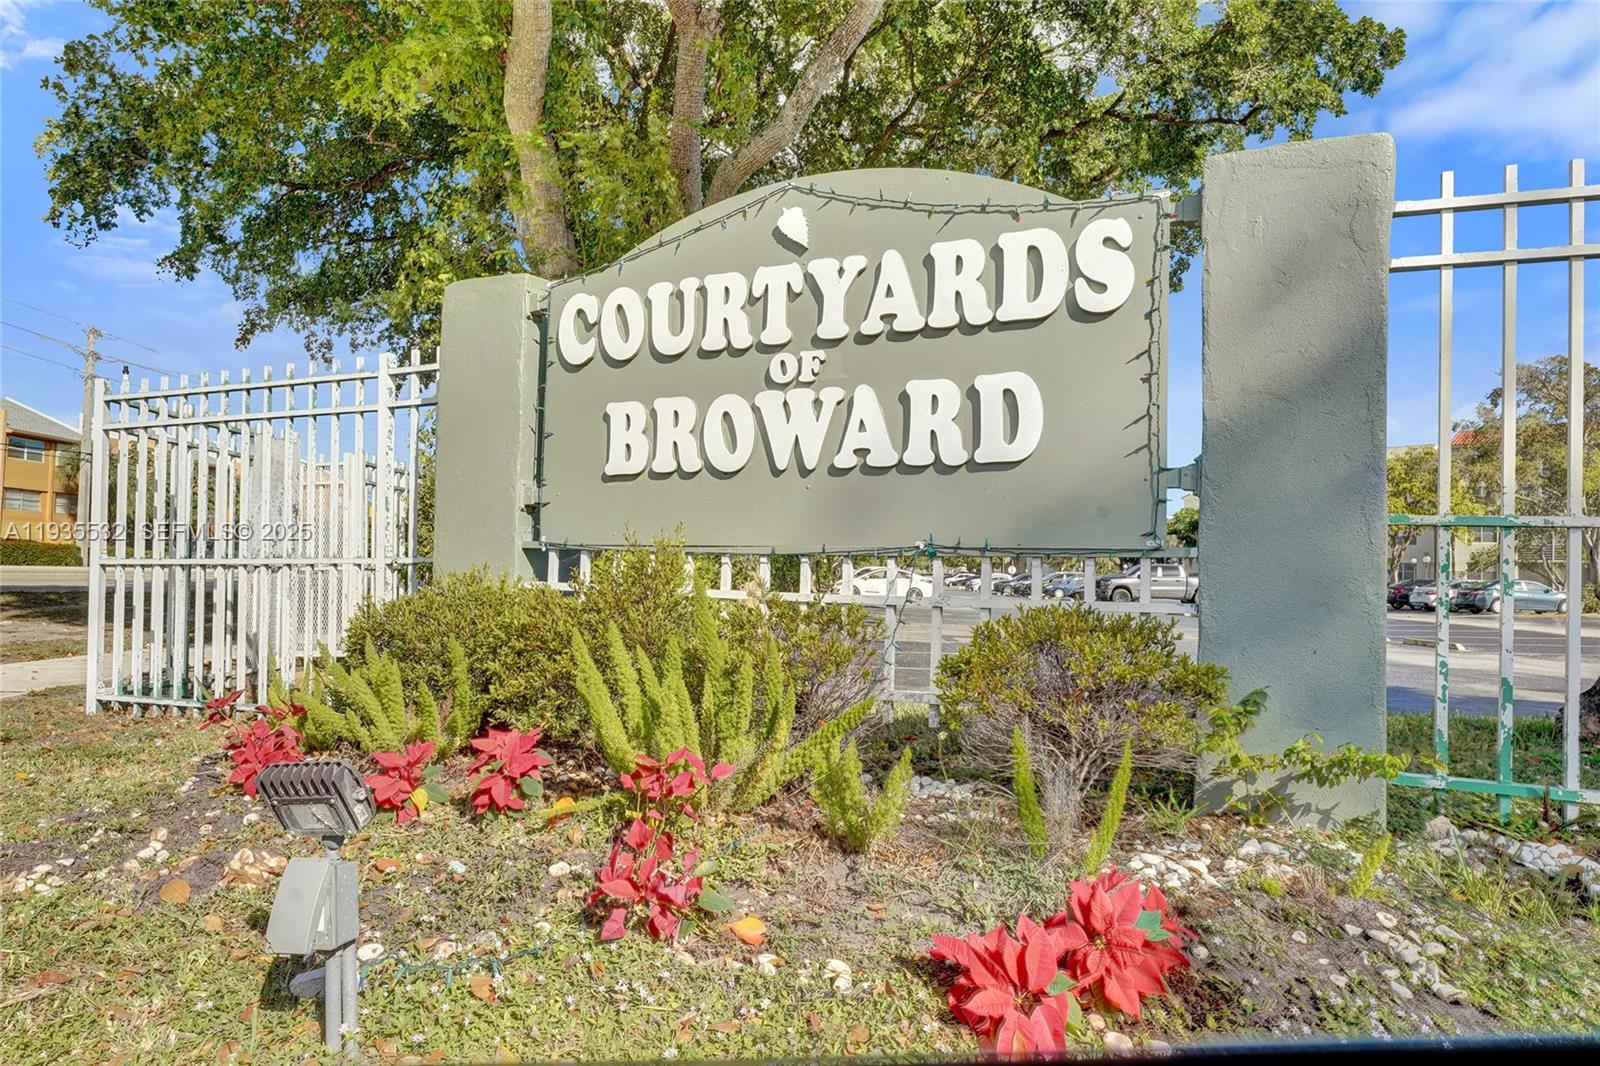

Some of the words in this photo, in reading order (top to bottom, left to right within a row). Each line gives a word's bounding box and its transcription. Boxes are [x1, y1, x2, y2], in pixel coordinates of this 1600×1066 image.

[558, 217, 1136, 366] COURTYARDS
[769, 350, 826, 384] OF
[604, 371, 1044, 477] BROWARD
